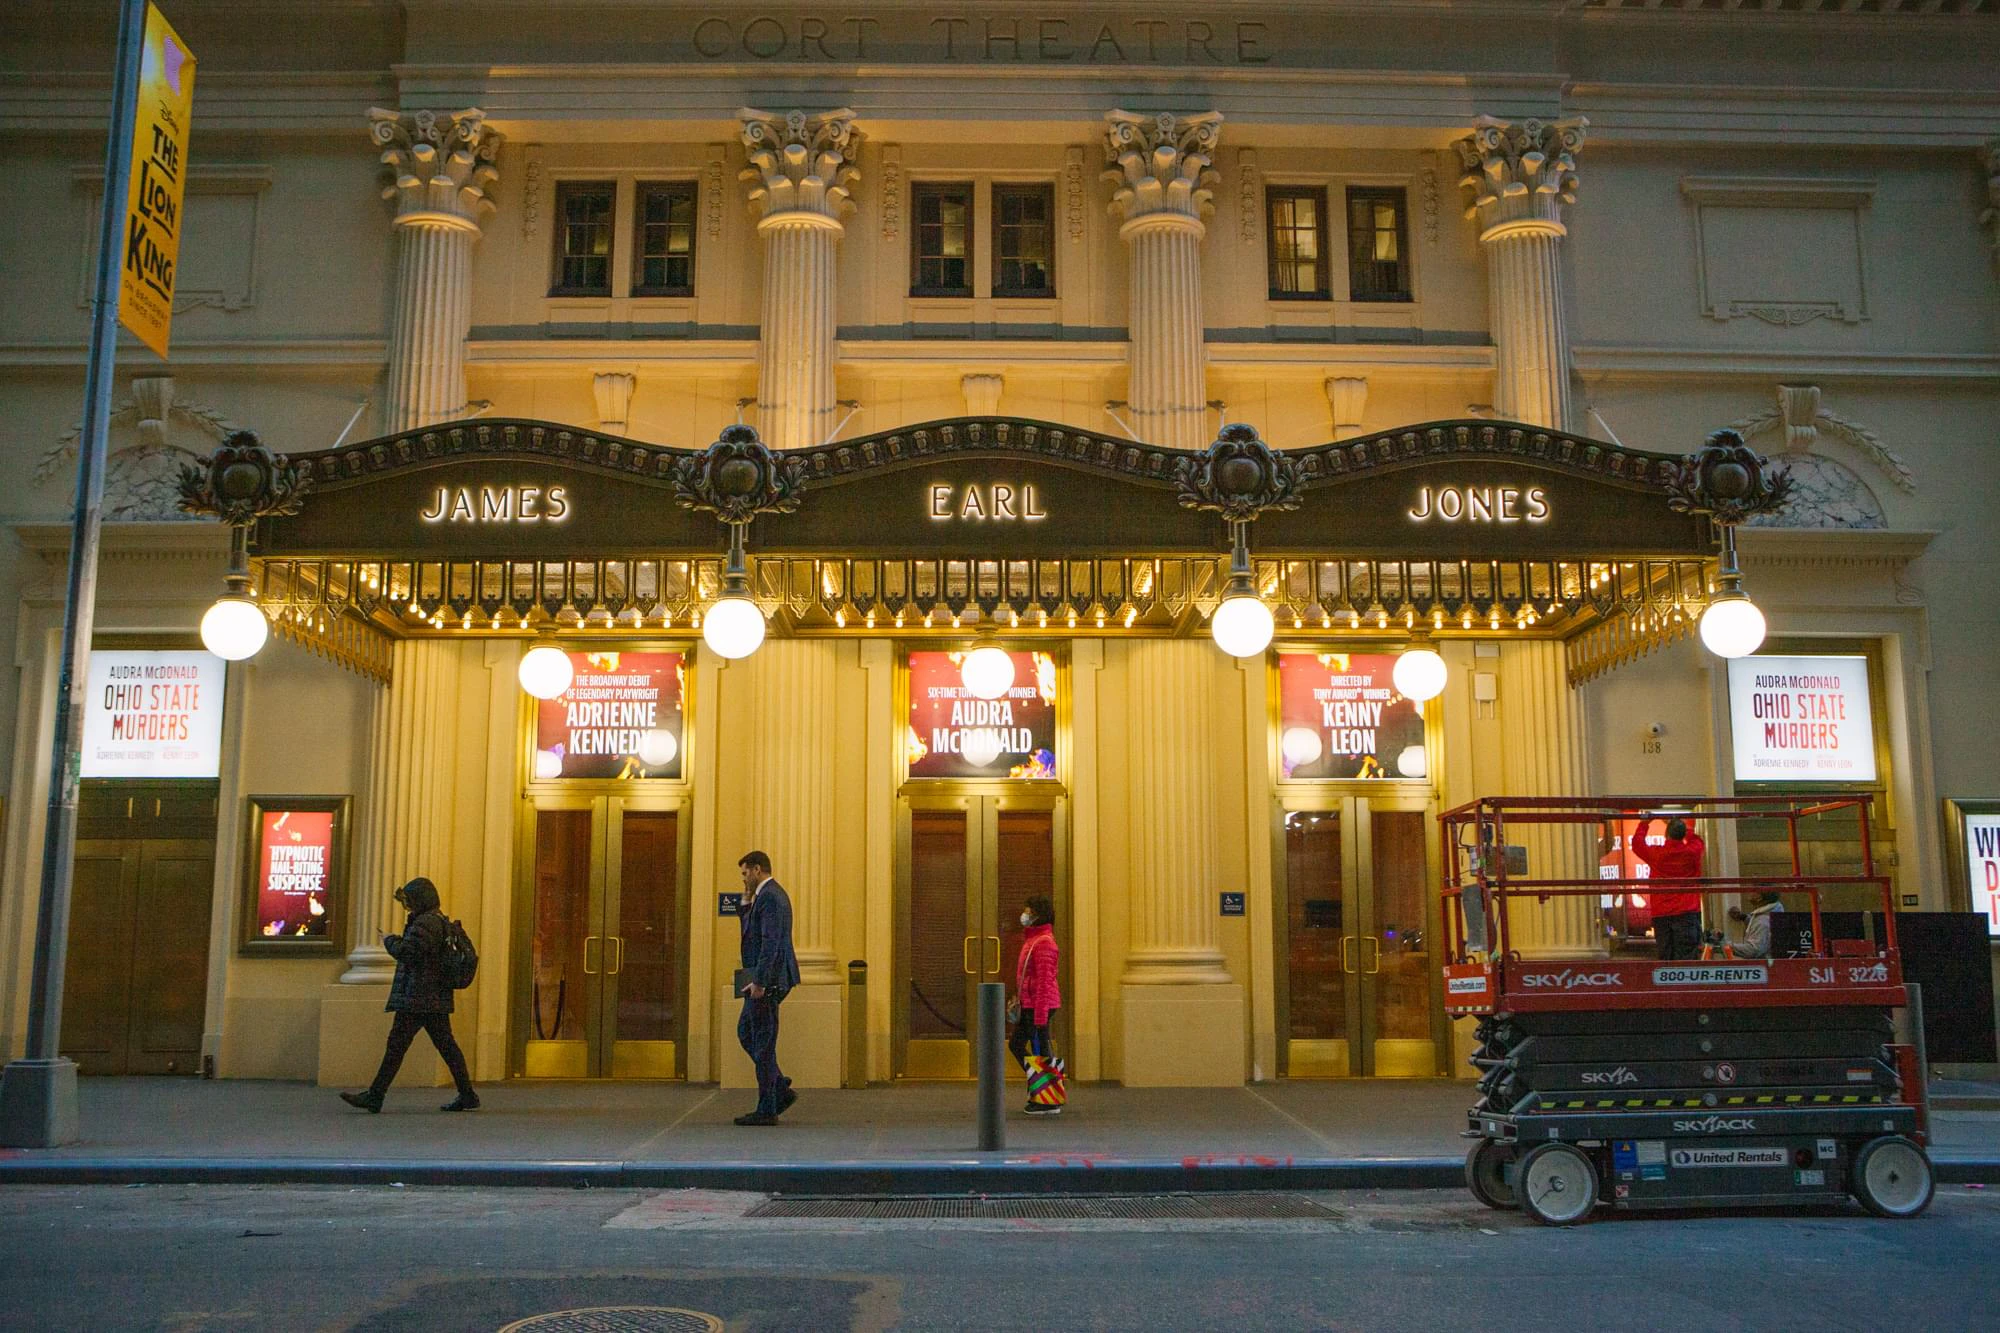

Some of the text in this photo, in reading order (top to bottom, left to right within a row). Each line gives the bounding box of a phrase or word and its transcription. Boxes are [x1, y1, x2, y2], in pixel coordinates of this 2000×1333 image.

[692, 16, 1273, 63] CORT THEATRE
[152, 122, 179, 175] THE
[139, 159, 177, 229] LION
[127, 213, 172, 292] KING
[421, 485, 569, 521] JAMES
[931, 484, 1046, 519] EARL
[1409, 486, 1549, 520] JONES
[110, 666, 198, 679] AUDRA McDONALD
[576, 675, 650, 686] THE BROADWAY DEBUT
[1331, 675, 1372, 687] DIRECTED BY
[1755, 675, 1840, 689] AUDRA McDONALD
[104, 684, 200, 711] OHIO STATE
[567, 688, 658, 700] OF LEGENDARY PLAYWRIGHT
[928, 687, 958, 699] SIX-TIME
[1009, 687, 1036, 699] WINNER
[1313, 688, 1331, 700] TONY
[1362, 688, 1391, 700] WINNER
[566, 702, 657, 727] ADRIENNE
[951, 701, 1013, 726] AUDRA
[1323, 702, 1382, 727] KENNY
[1753, 693, 1846, 720] OHIO STATE
[112, 714, 189, 741] MURDERS
[1764, 722, 1838, 749] MURDERS
[1332, 729, 1376, 754] LEON
[1643, 741, 1661, 754] 138
[1753, 759, 1781, 768] ADRIENNE
[1783, 759, 1809, 768] KENNEDY
[1522, 968, 1623, 989] SKYJACK
[1659, 969, 1762, 982] 800-UR-RENTS
[1673, 1115, 1756, 1133] SKYJACK
[1693, 1151, 1782, 1164] United Rentals
